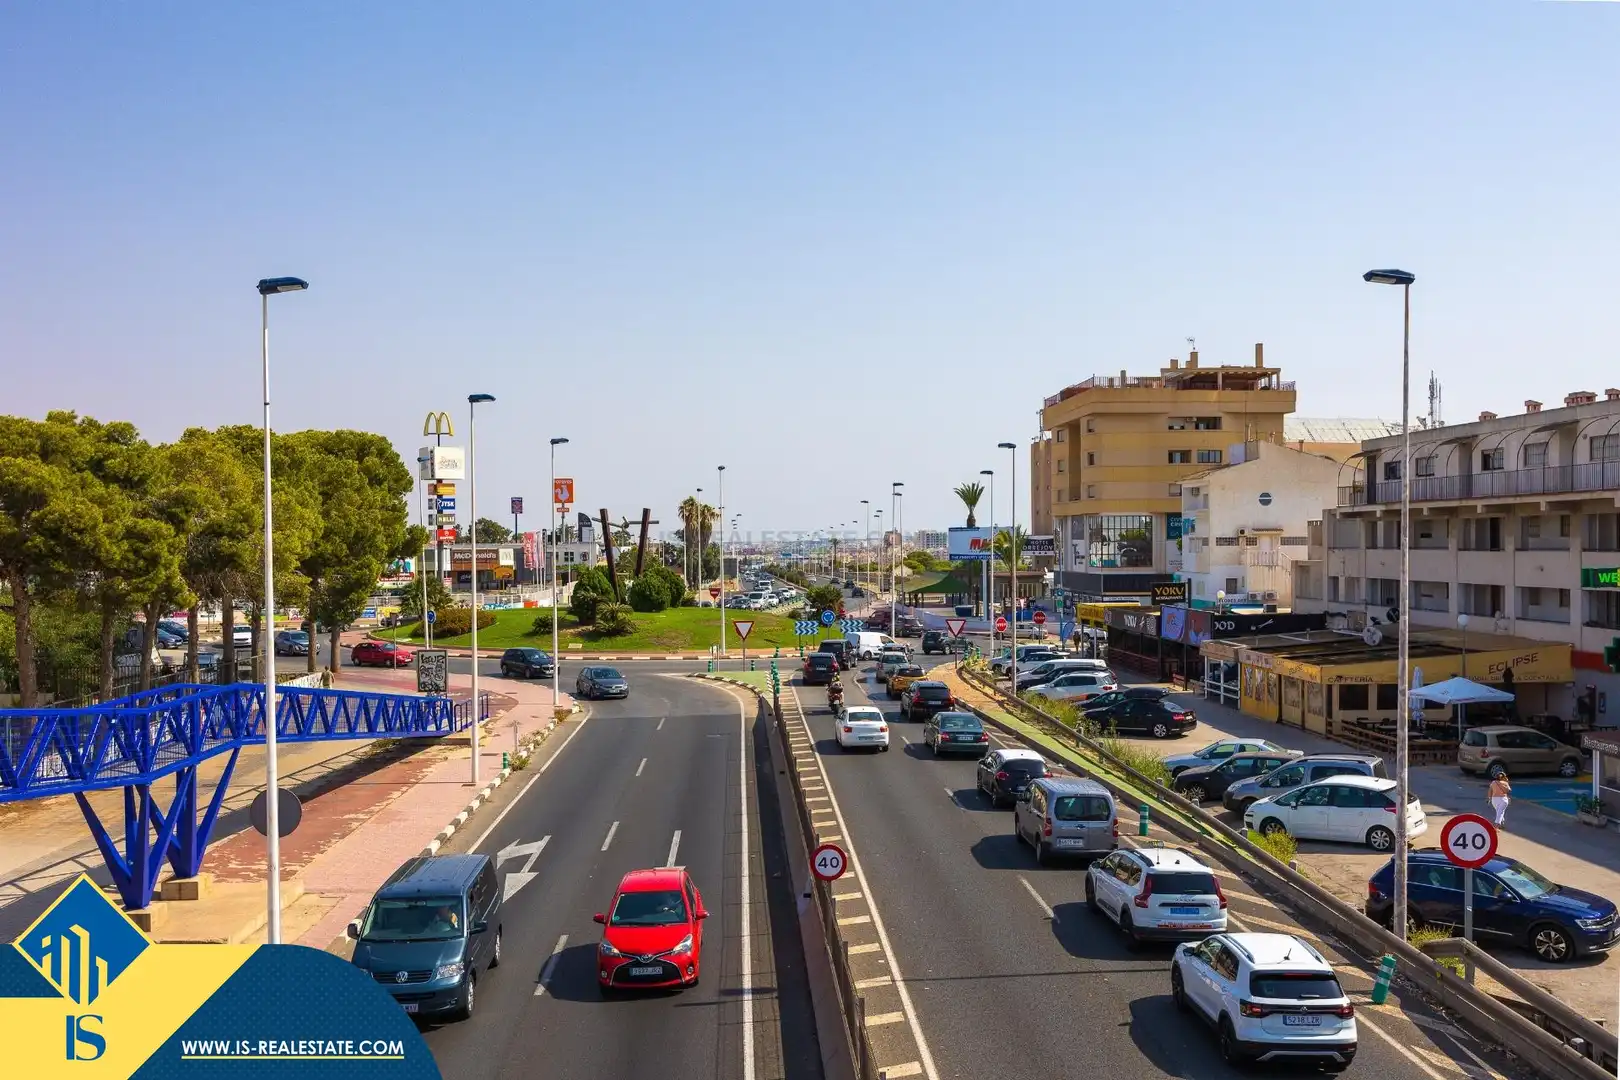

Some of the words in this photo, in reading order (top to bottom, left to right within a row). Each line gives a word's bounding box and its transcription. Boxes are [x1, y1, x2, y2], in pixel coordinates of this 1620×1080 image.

[453, 551, 497, 560] McDnald's
[1488, 652, 1539, 675] ECLIPSE
[1452, 832, 1486, 850] 40
[817, 856, 840, 869] 40
